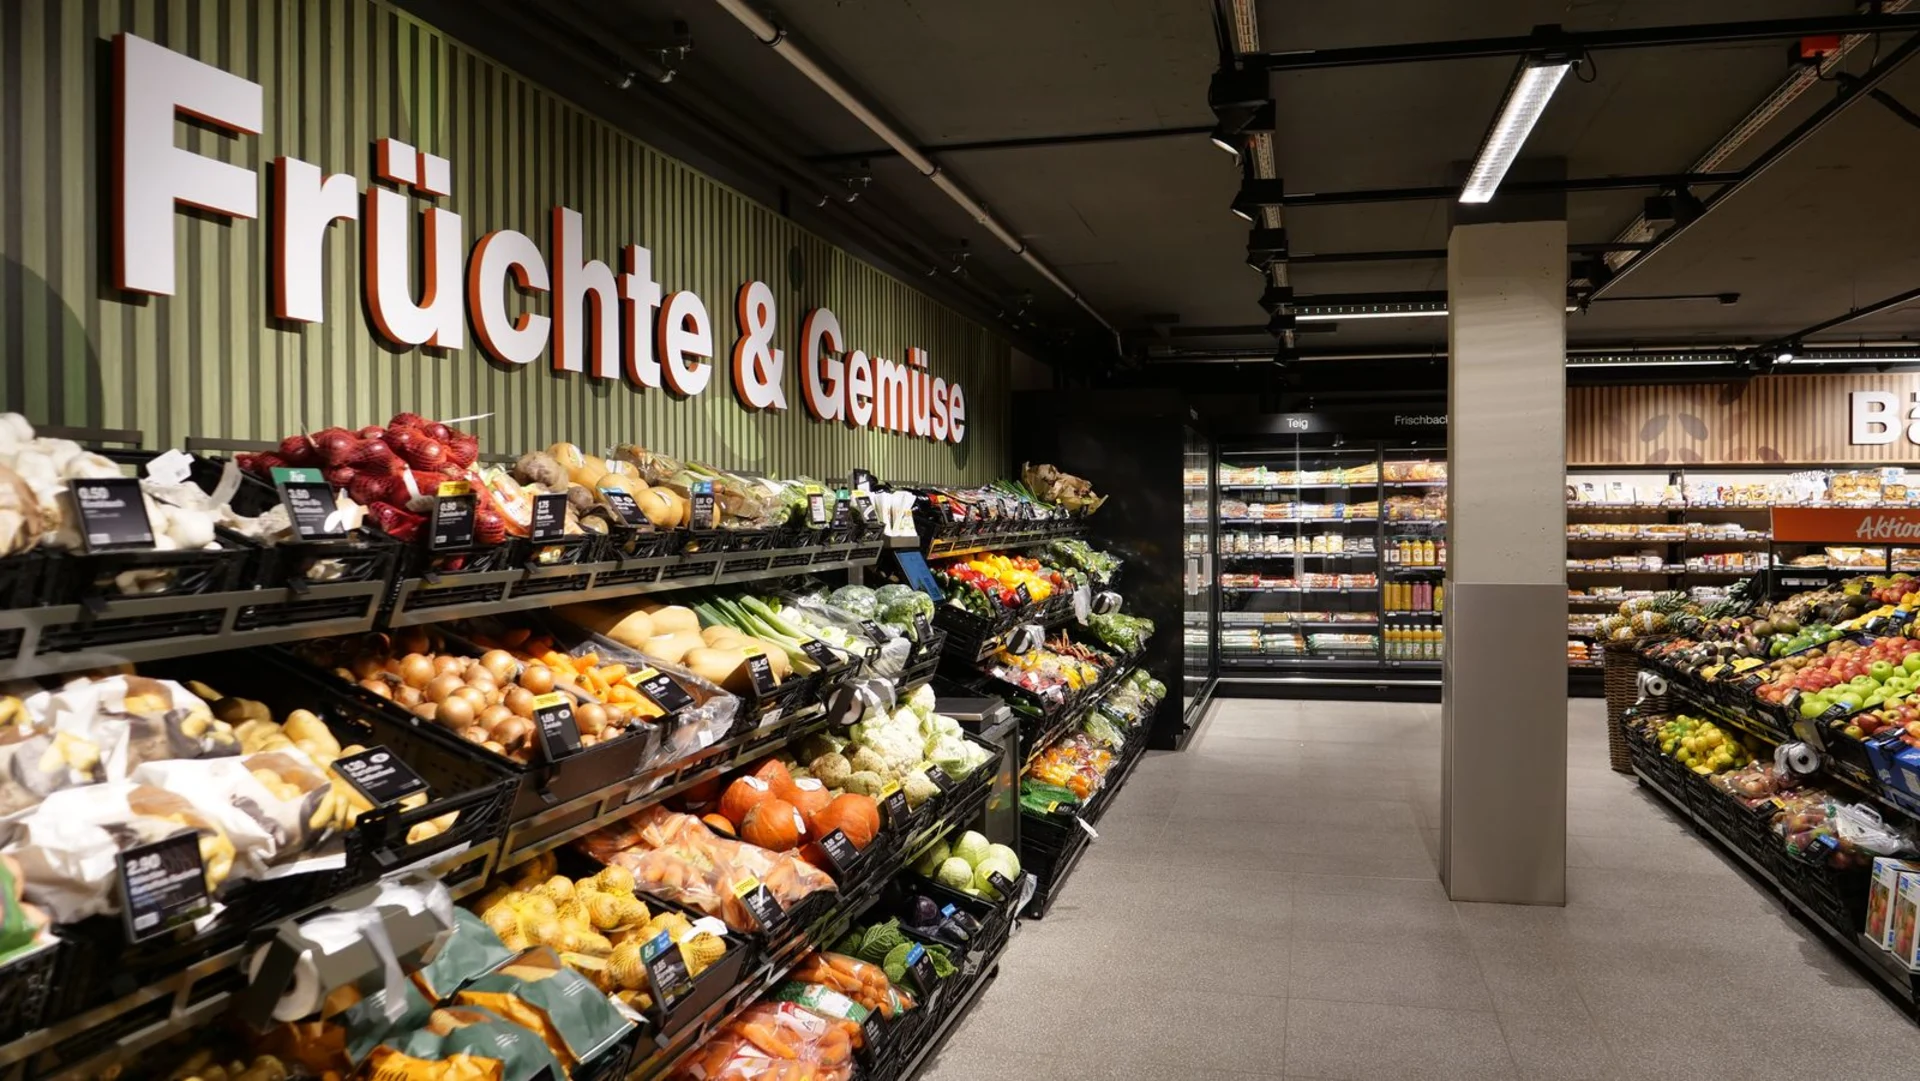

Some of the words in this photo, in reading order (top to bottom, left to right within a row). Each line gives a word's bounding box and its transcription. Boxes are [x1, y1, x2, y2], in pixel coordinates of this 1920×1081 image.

[113, 32, 713, 396] Früchte
[734, 279, 788, 410] &
[802, 307, 966, 444] Gemüse
[1286, 417, 1309, 430] Teig
